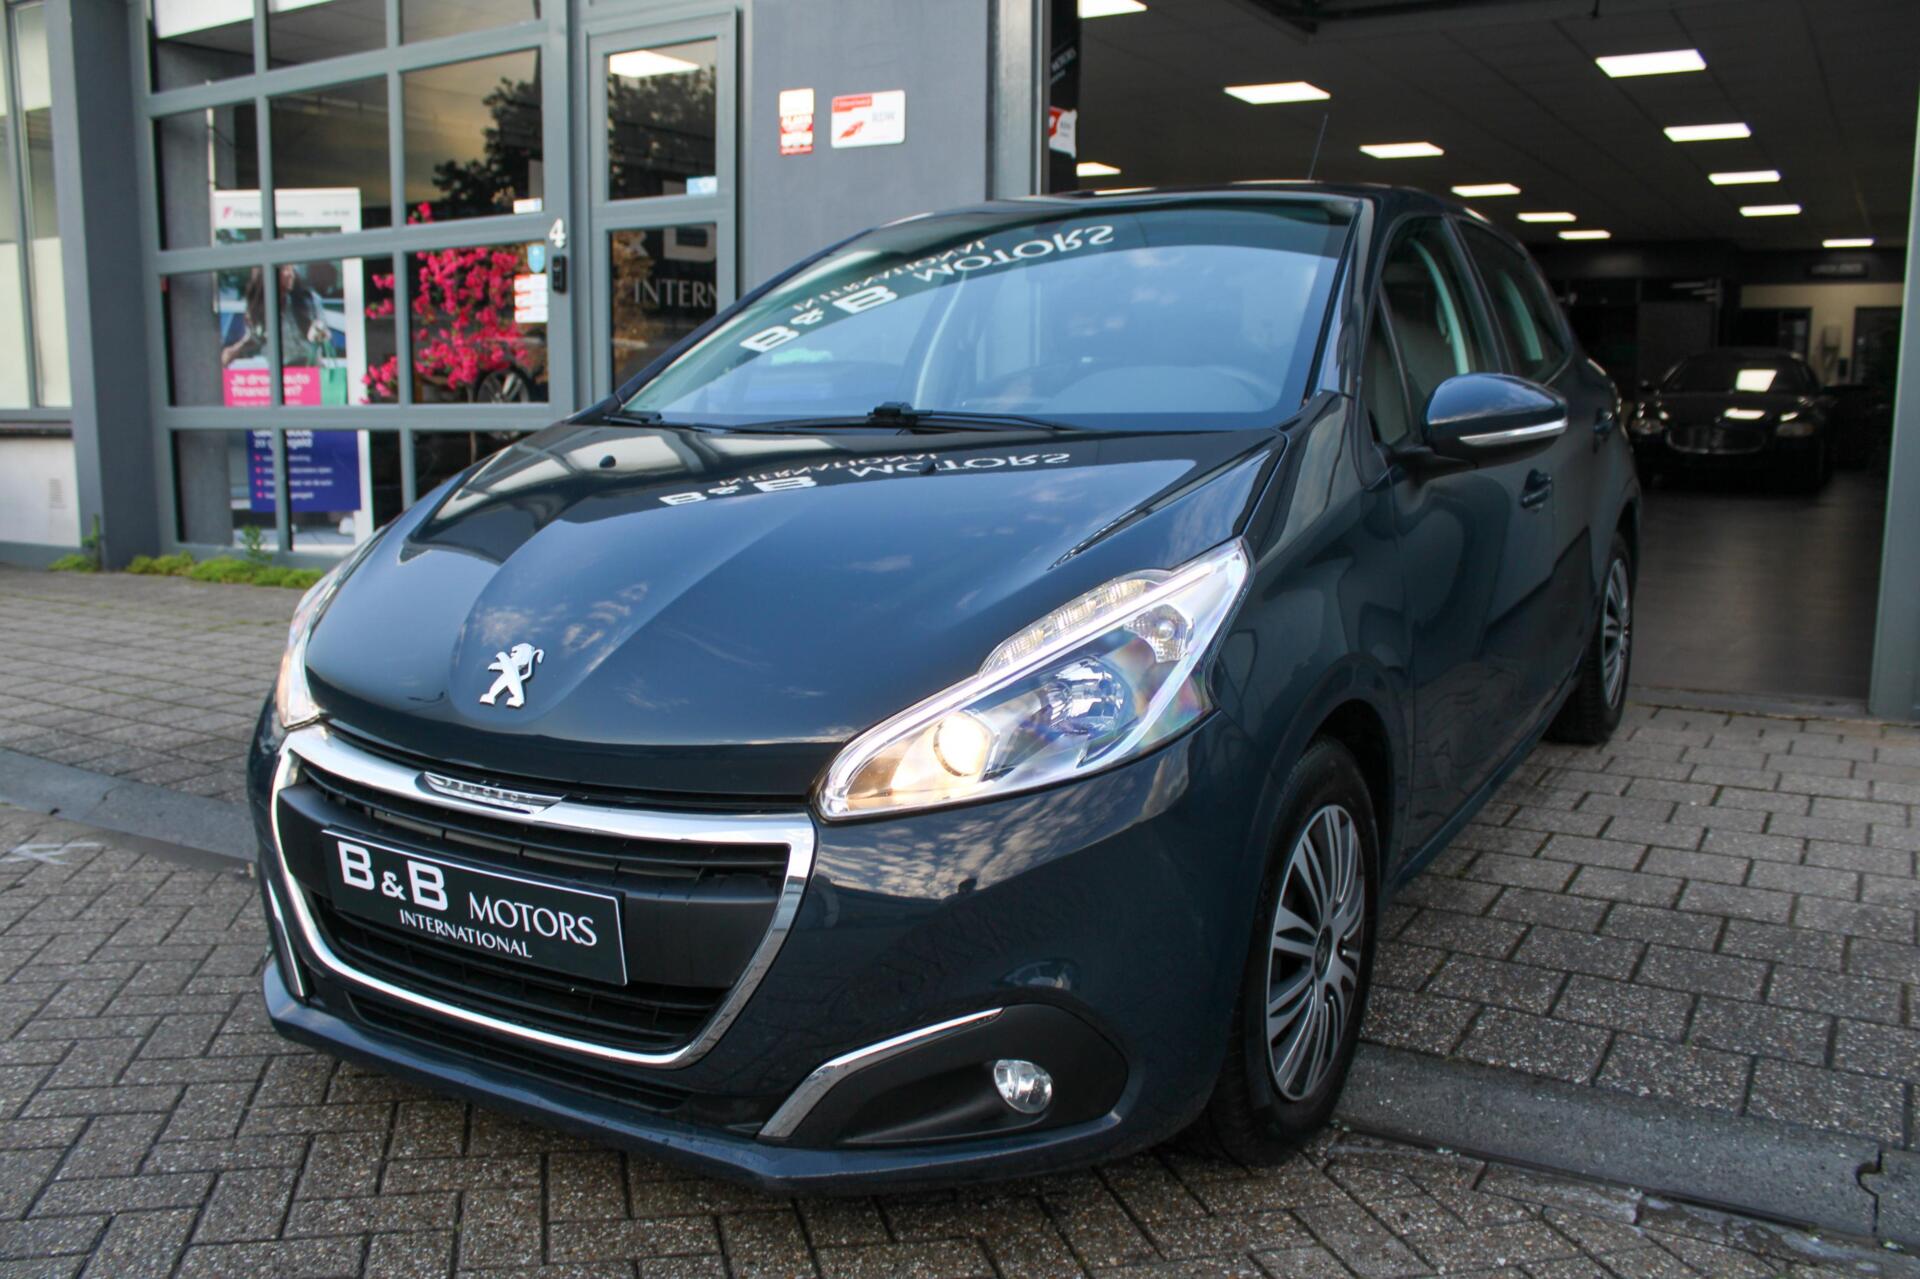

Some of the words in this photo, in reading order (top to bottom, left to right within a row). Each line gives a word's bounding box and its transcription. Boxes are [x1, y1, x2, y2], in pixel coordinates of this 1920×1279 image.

[549, 218, 566, 248] 4
[337, 840, 375, 891] B
[380, 870, 407, 901] &
[407, 859, 449, 912] B
[468, 891, 597, 947] MOTORS
[399, 909, 533, 959] INTERNATIONAL
